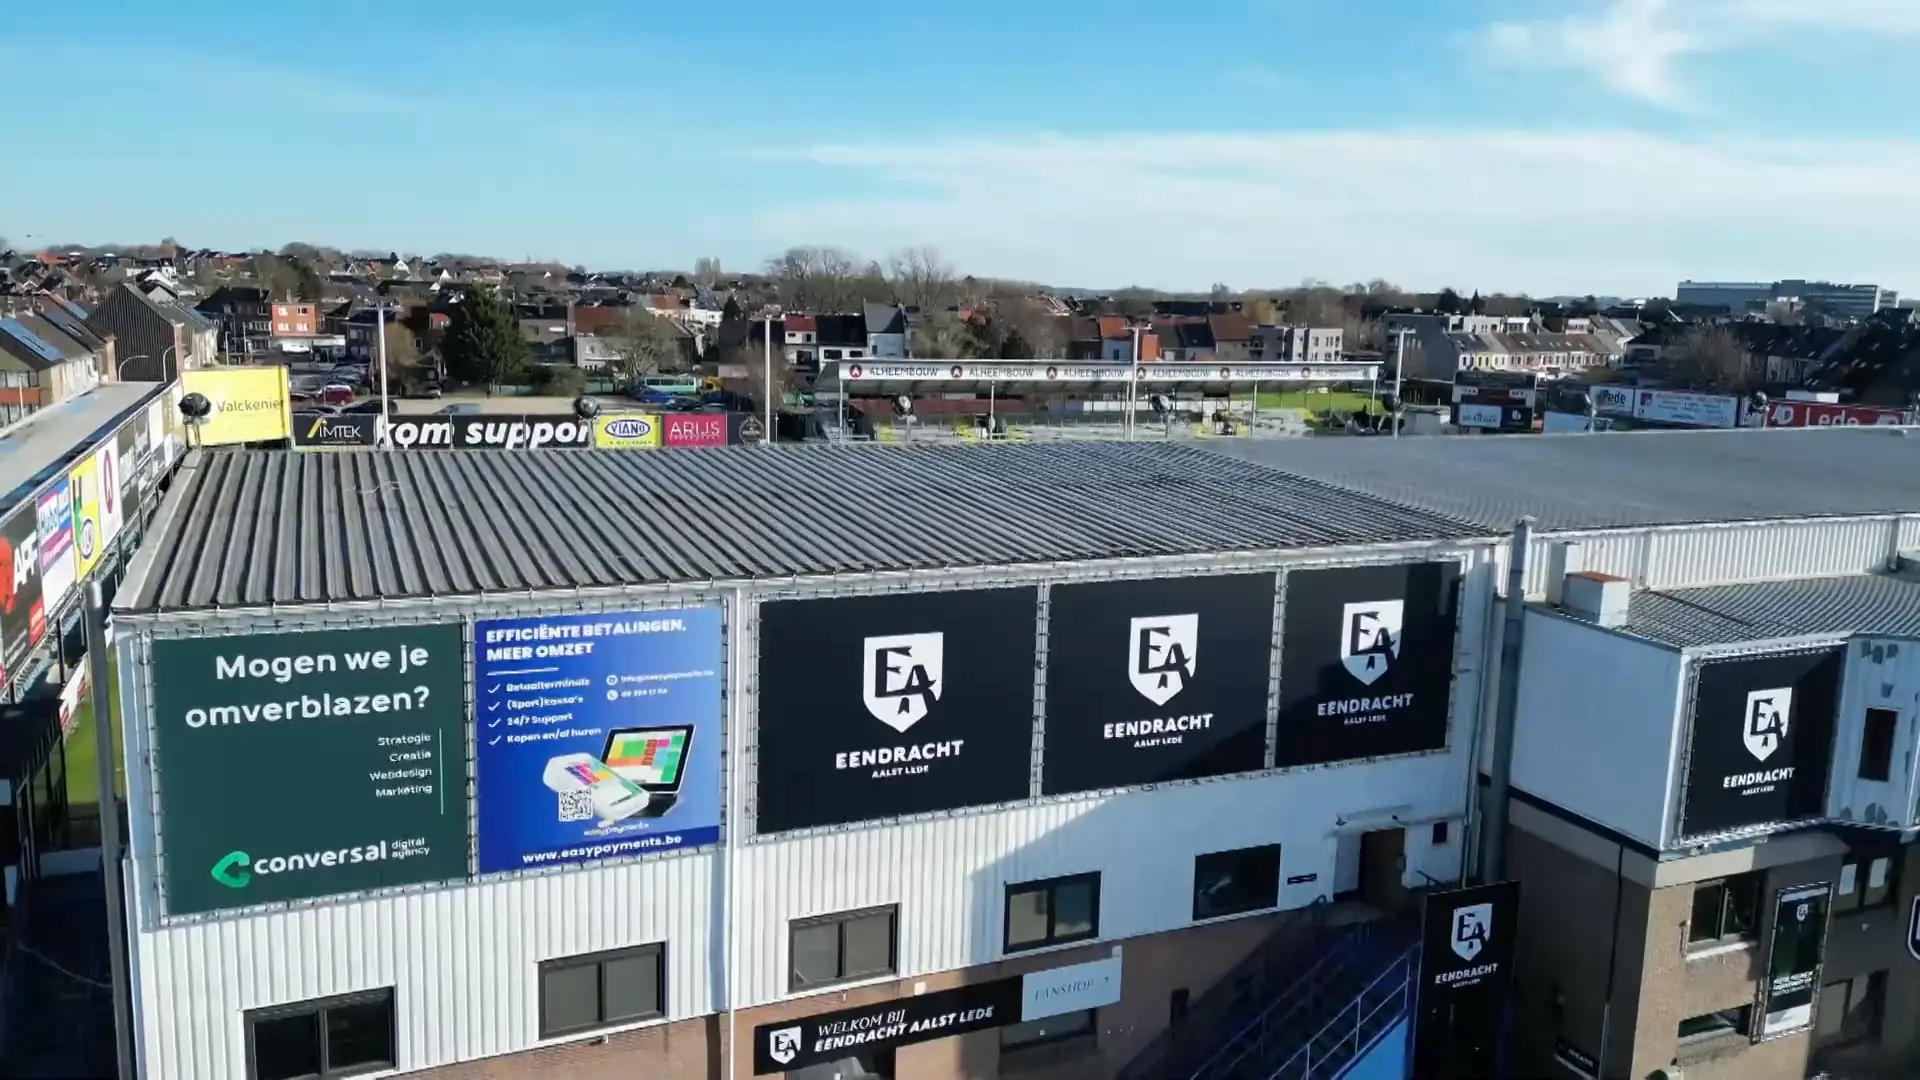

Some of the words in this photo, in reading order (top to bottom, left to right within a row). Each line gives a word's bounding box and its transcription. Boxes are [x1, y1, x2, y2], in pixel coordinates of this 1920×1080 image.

[611, 421, 646, 437] VIANO
[671, 422, 720, 436] ARIJS
[486, 624, 580, 643] EFFICIËNTE
[486, 646, 532, 661] MEER
[536, 642, 594, 658] OMZET
[215, 652, 336, 683] Mogen
[344, 650, 391, 671] we
[399, 644, 429, 673] je
[185, 685, 430, 728] omverblazen?
[1318, 693, 1414, 716] EENDRACHT
[507, 715, 530, 726] 24/7
[532, 712, 573, 725] Support
[1104, 713, 1214, 739] EENDRACHT
[378, 732, 431, 746] Strategie
[507, 733, 540, 743] Kopen
[571, 728, 601, 737] huren
[1162, 736, 1183, 745] LEDE
[389, 750, 431, 763] Creatie
[835, 740, 964, 769] EENDRACHT
[369, 767, 432, 781] Webdesign
[872, 767, 903, 779] AALST
[905, 765, 929, 775] LEDE
[1723, 767, 1795, 788] EENDRACHT
[375, 784, 433, 797] Marketing
[391, 837, 425, 850] digital
[391, 846, 430, 859] agency
[522, 835, 682, 863] www.easypayments.be
[254, 841, 387, 875] conversal
[1435, 963, 1499, 984] EENDRACHT
[814, 1023, 909, 1052] EENDRACHT
[909, 1013, 957, 1034] AALST
[959, 1005, 995, 1023] LEDE
[818, 1013, 882, 1036] WELKOM
[887, 1009, 906, 1025] BIJ
